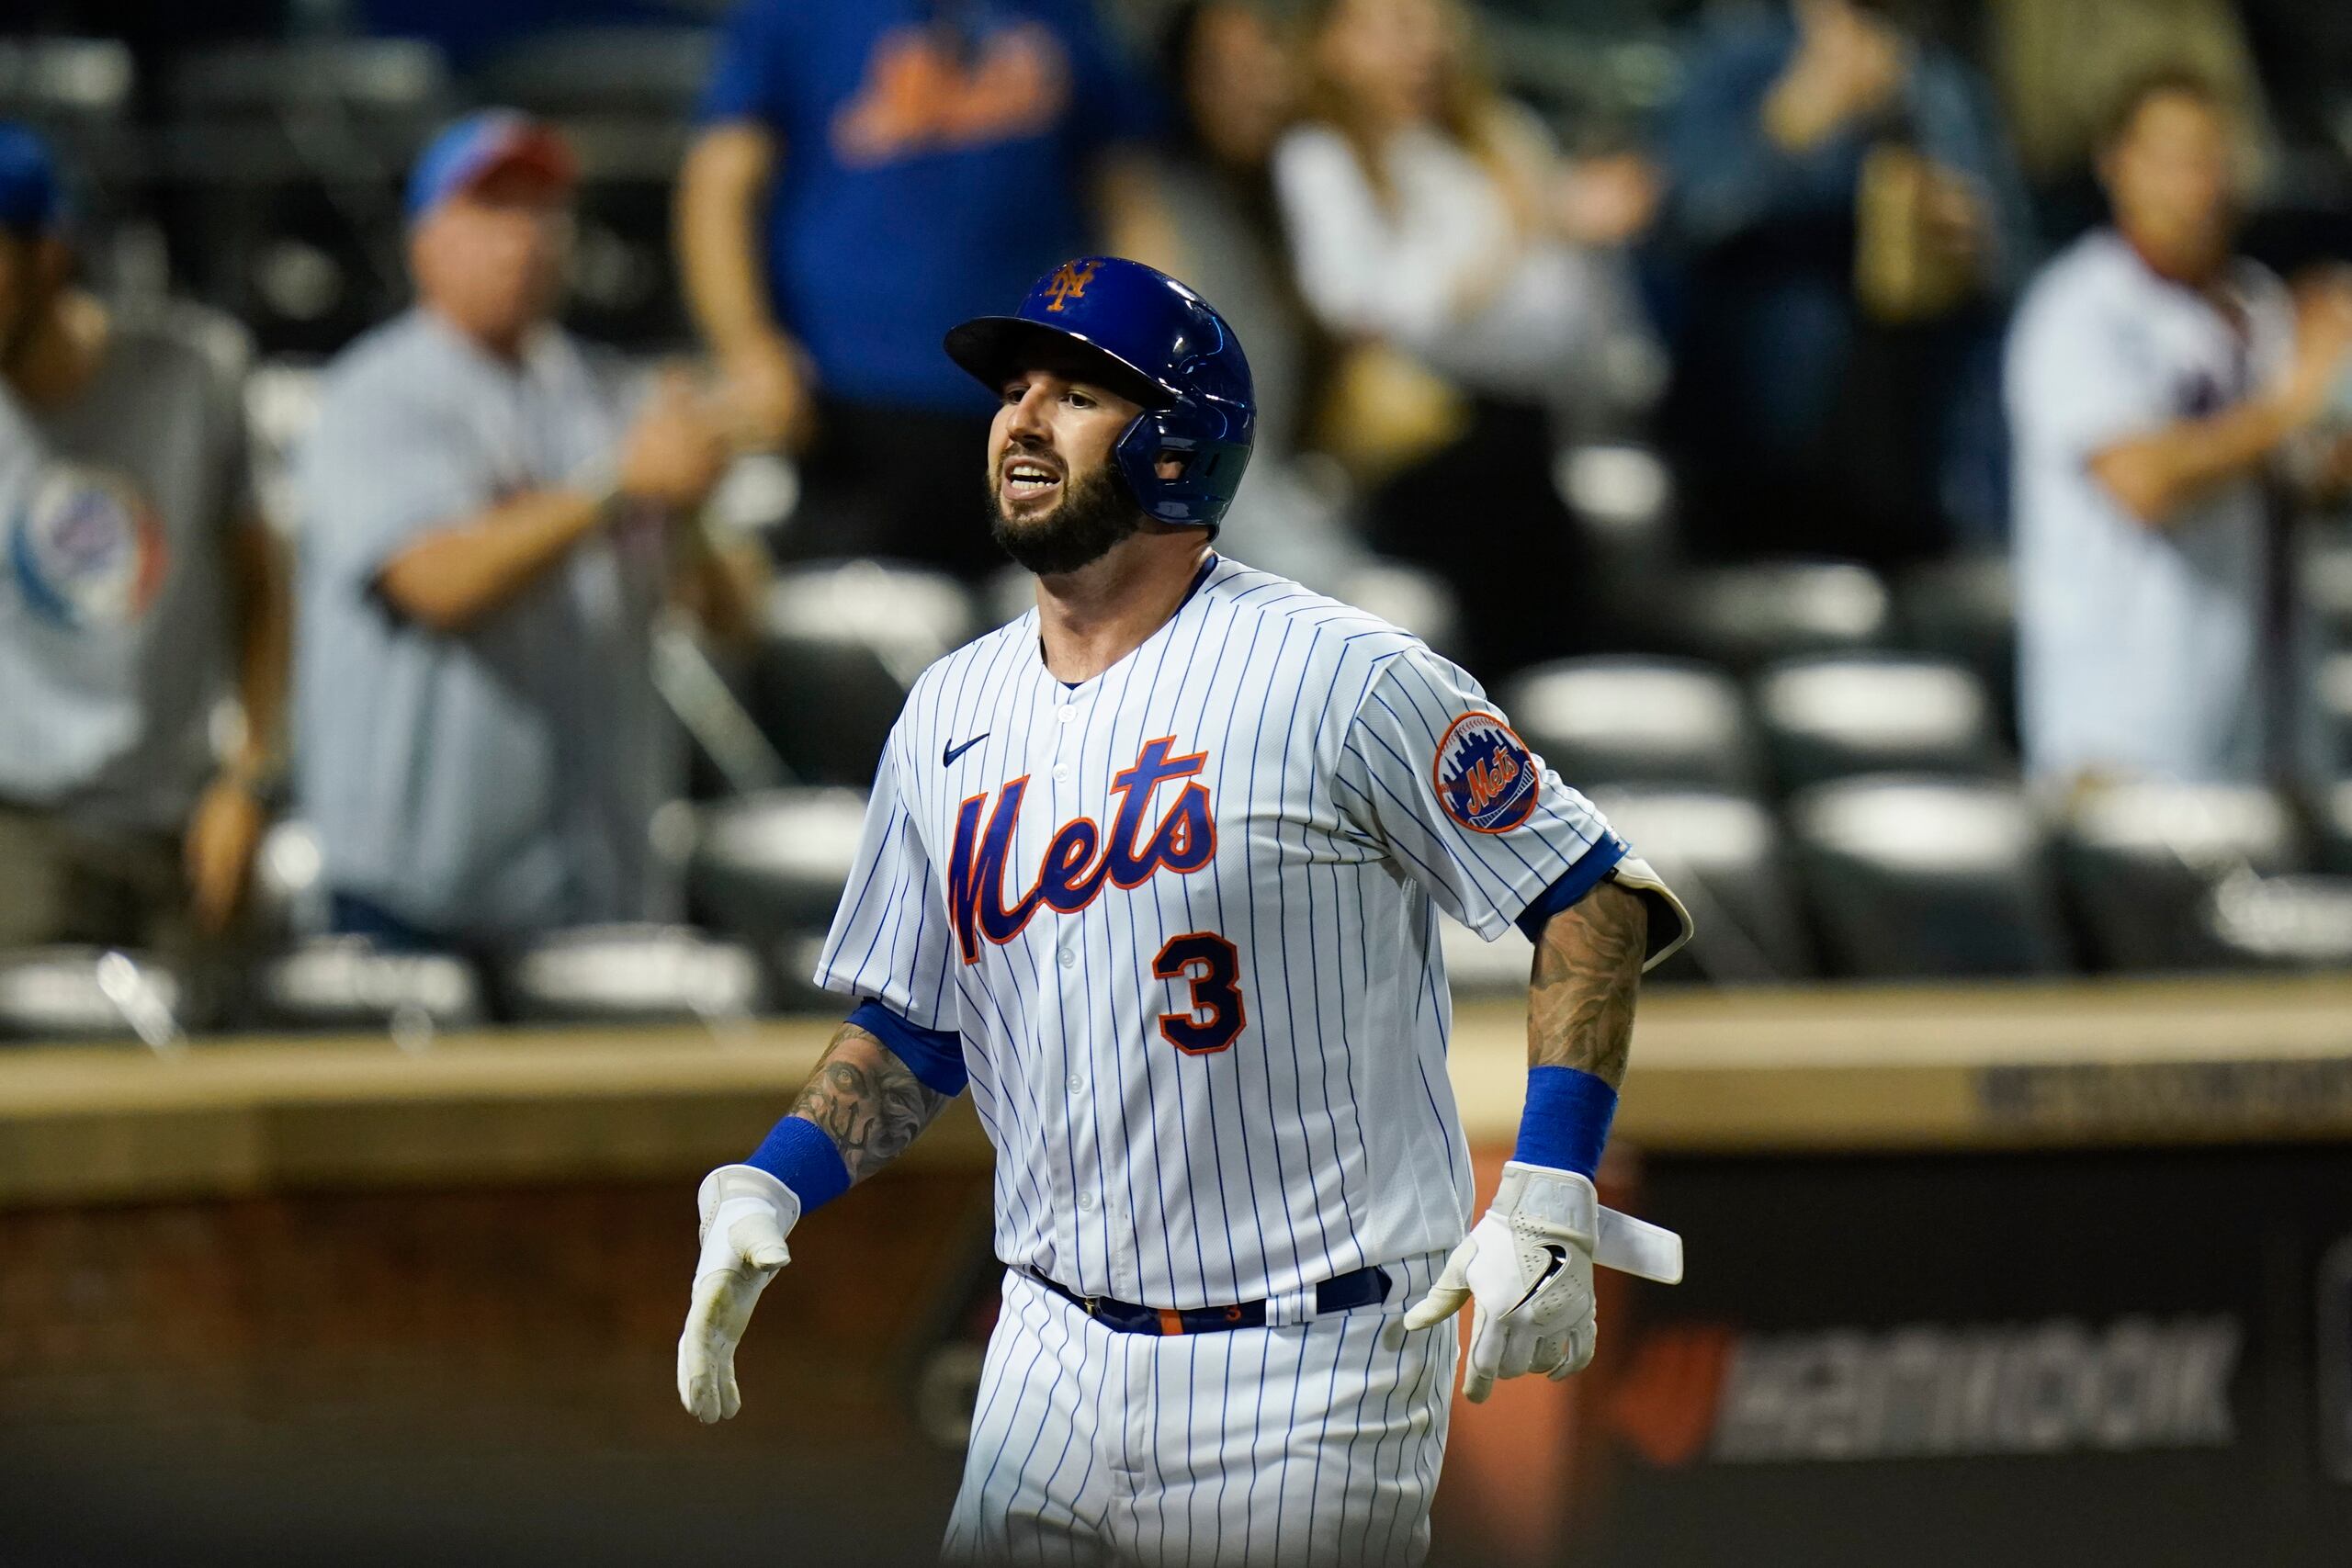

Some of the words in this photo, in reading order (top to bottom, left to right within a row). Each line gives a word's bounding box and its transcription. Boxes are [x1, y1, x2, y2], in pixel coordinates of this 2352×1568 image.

[1466, 747, 1519, 815] Mets
[948, 735, 1217, 964] Mets
[1153, 931, 1247, 1055] 3
